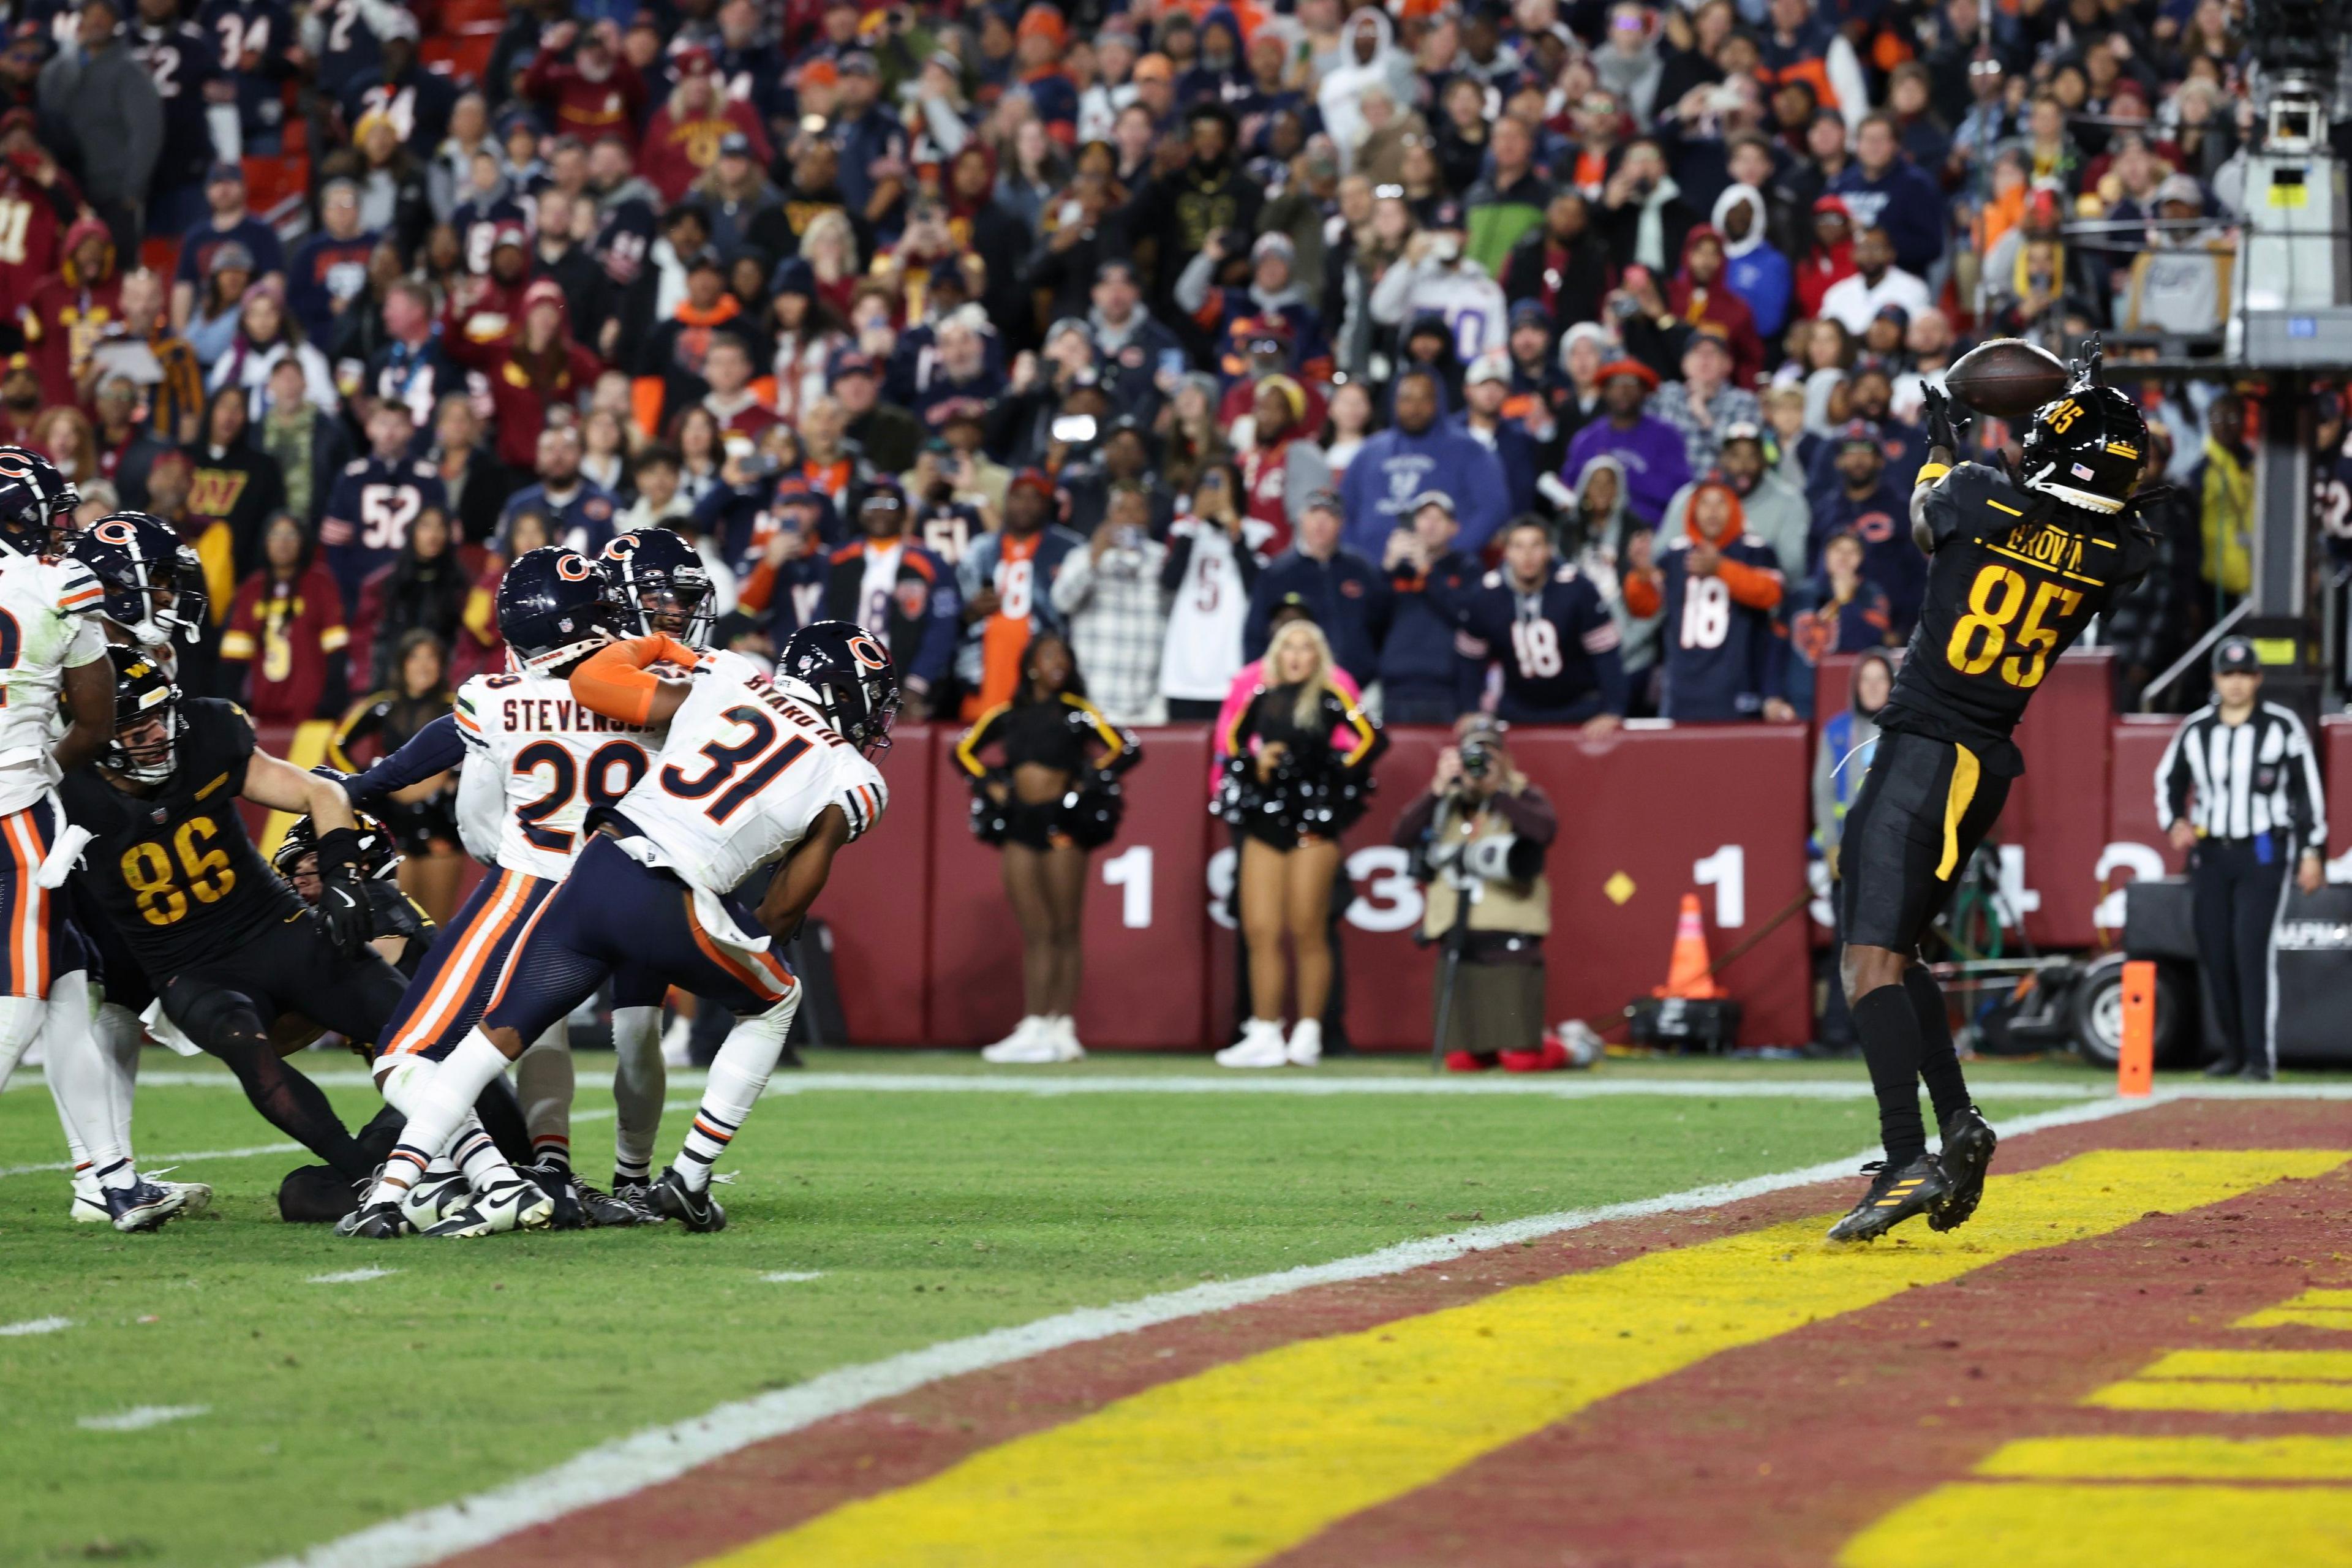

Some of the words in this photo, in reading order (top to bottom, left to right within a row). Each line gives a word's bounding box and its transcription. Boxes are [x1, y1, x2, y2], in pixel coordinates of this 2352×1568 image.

[2046, 397, 2085, 435] 85
[362, 483, 421, 549] 52
[1195, 555, 1220, 614] 5
[1679, 575, 1730, 650] 18
[1511, 619, 1562, 678] 18
[1946, 564, 2084, 688] 85
[503, 699, 656, 733] STEVEN
[512, 739, 650, 855] 29
[660, 704, 815, 826] 31
[120, 816, 236, 925] 86
